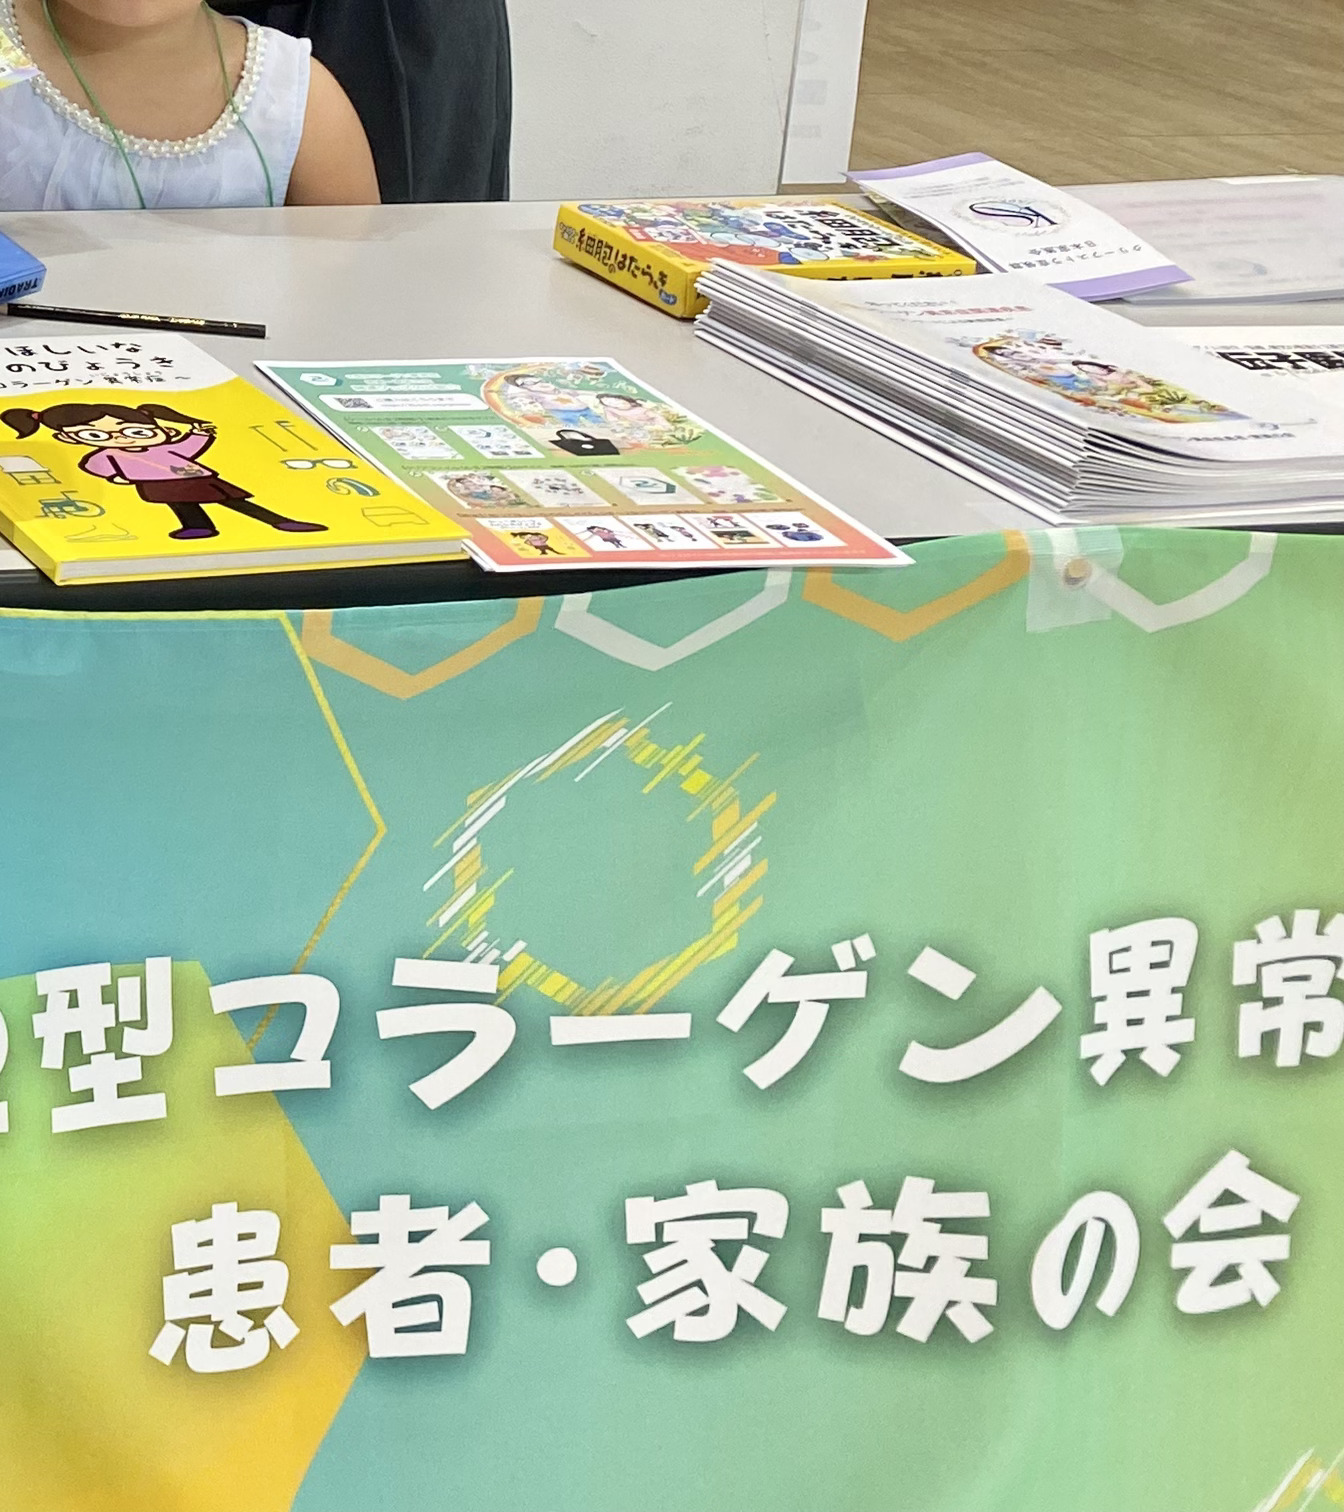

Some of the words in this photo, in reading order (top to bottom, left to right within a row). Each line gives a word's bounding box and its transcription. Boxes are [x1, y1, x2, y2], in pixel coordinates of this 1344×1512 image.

[145, 1148, 1302, 1376] 患者・家族の会
